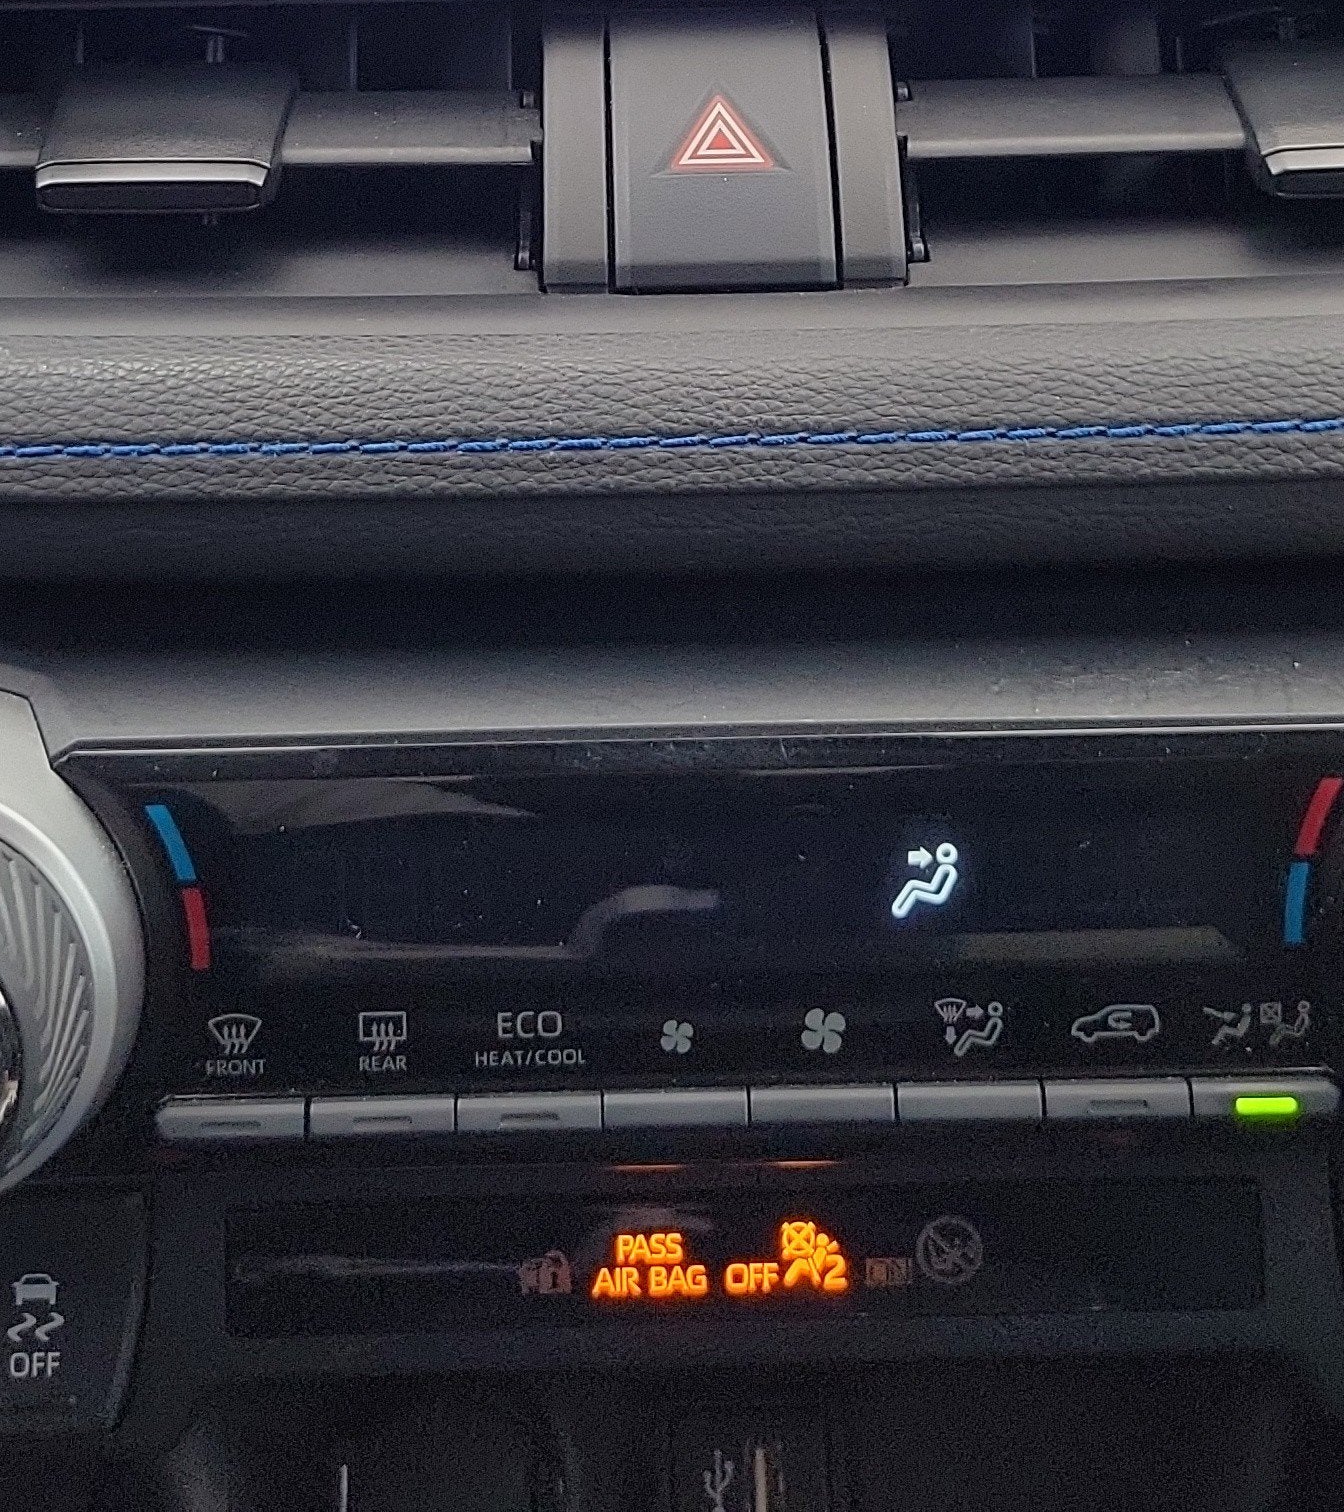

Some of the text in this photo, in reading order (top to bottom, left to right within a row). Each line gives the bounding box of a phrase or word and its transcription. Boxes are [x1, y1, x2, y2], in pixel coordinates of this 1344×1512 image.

[496, 1010, 564, 1039] ECO
[205, 1058, 267, 1077] FRONT
[358, 1054, 407, 1073] REAR
[475, 1048, 587, 1068] HEAT/COOL
[616, 1232, 684, 1265] PASS
[590, 1261, 780, 1299] AIR BAG OFF
[9, 1351, 62, 1379] OFF
